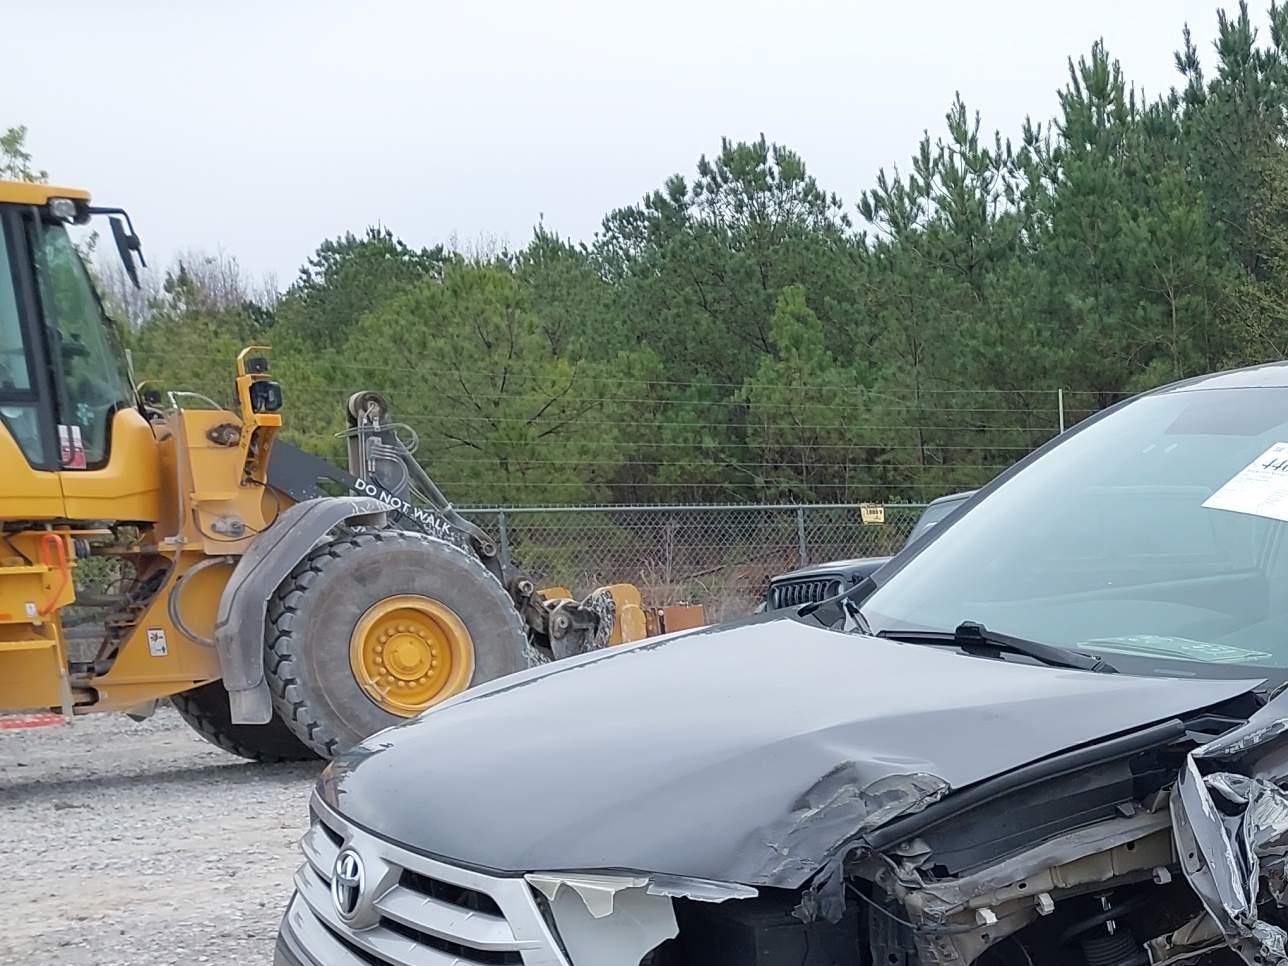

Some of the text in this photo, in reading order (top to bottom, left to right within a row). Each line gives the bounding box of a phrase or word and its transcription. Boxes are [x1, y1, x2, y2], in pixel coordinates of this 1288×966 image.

[354, 478, 377, 496] DO
[379, 491, 411, 514] NOT
[414, 506, 451, 535] WALK
